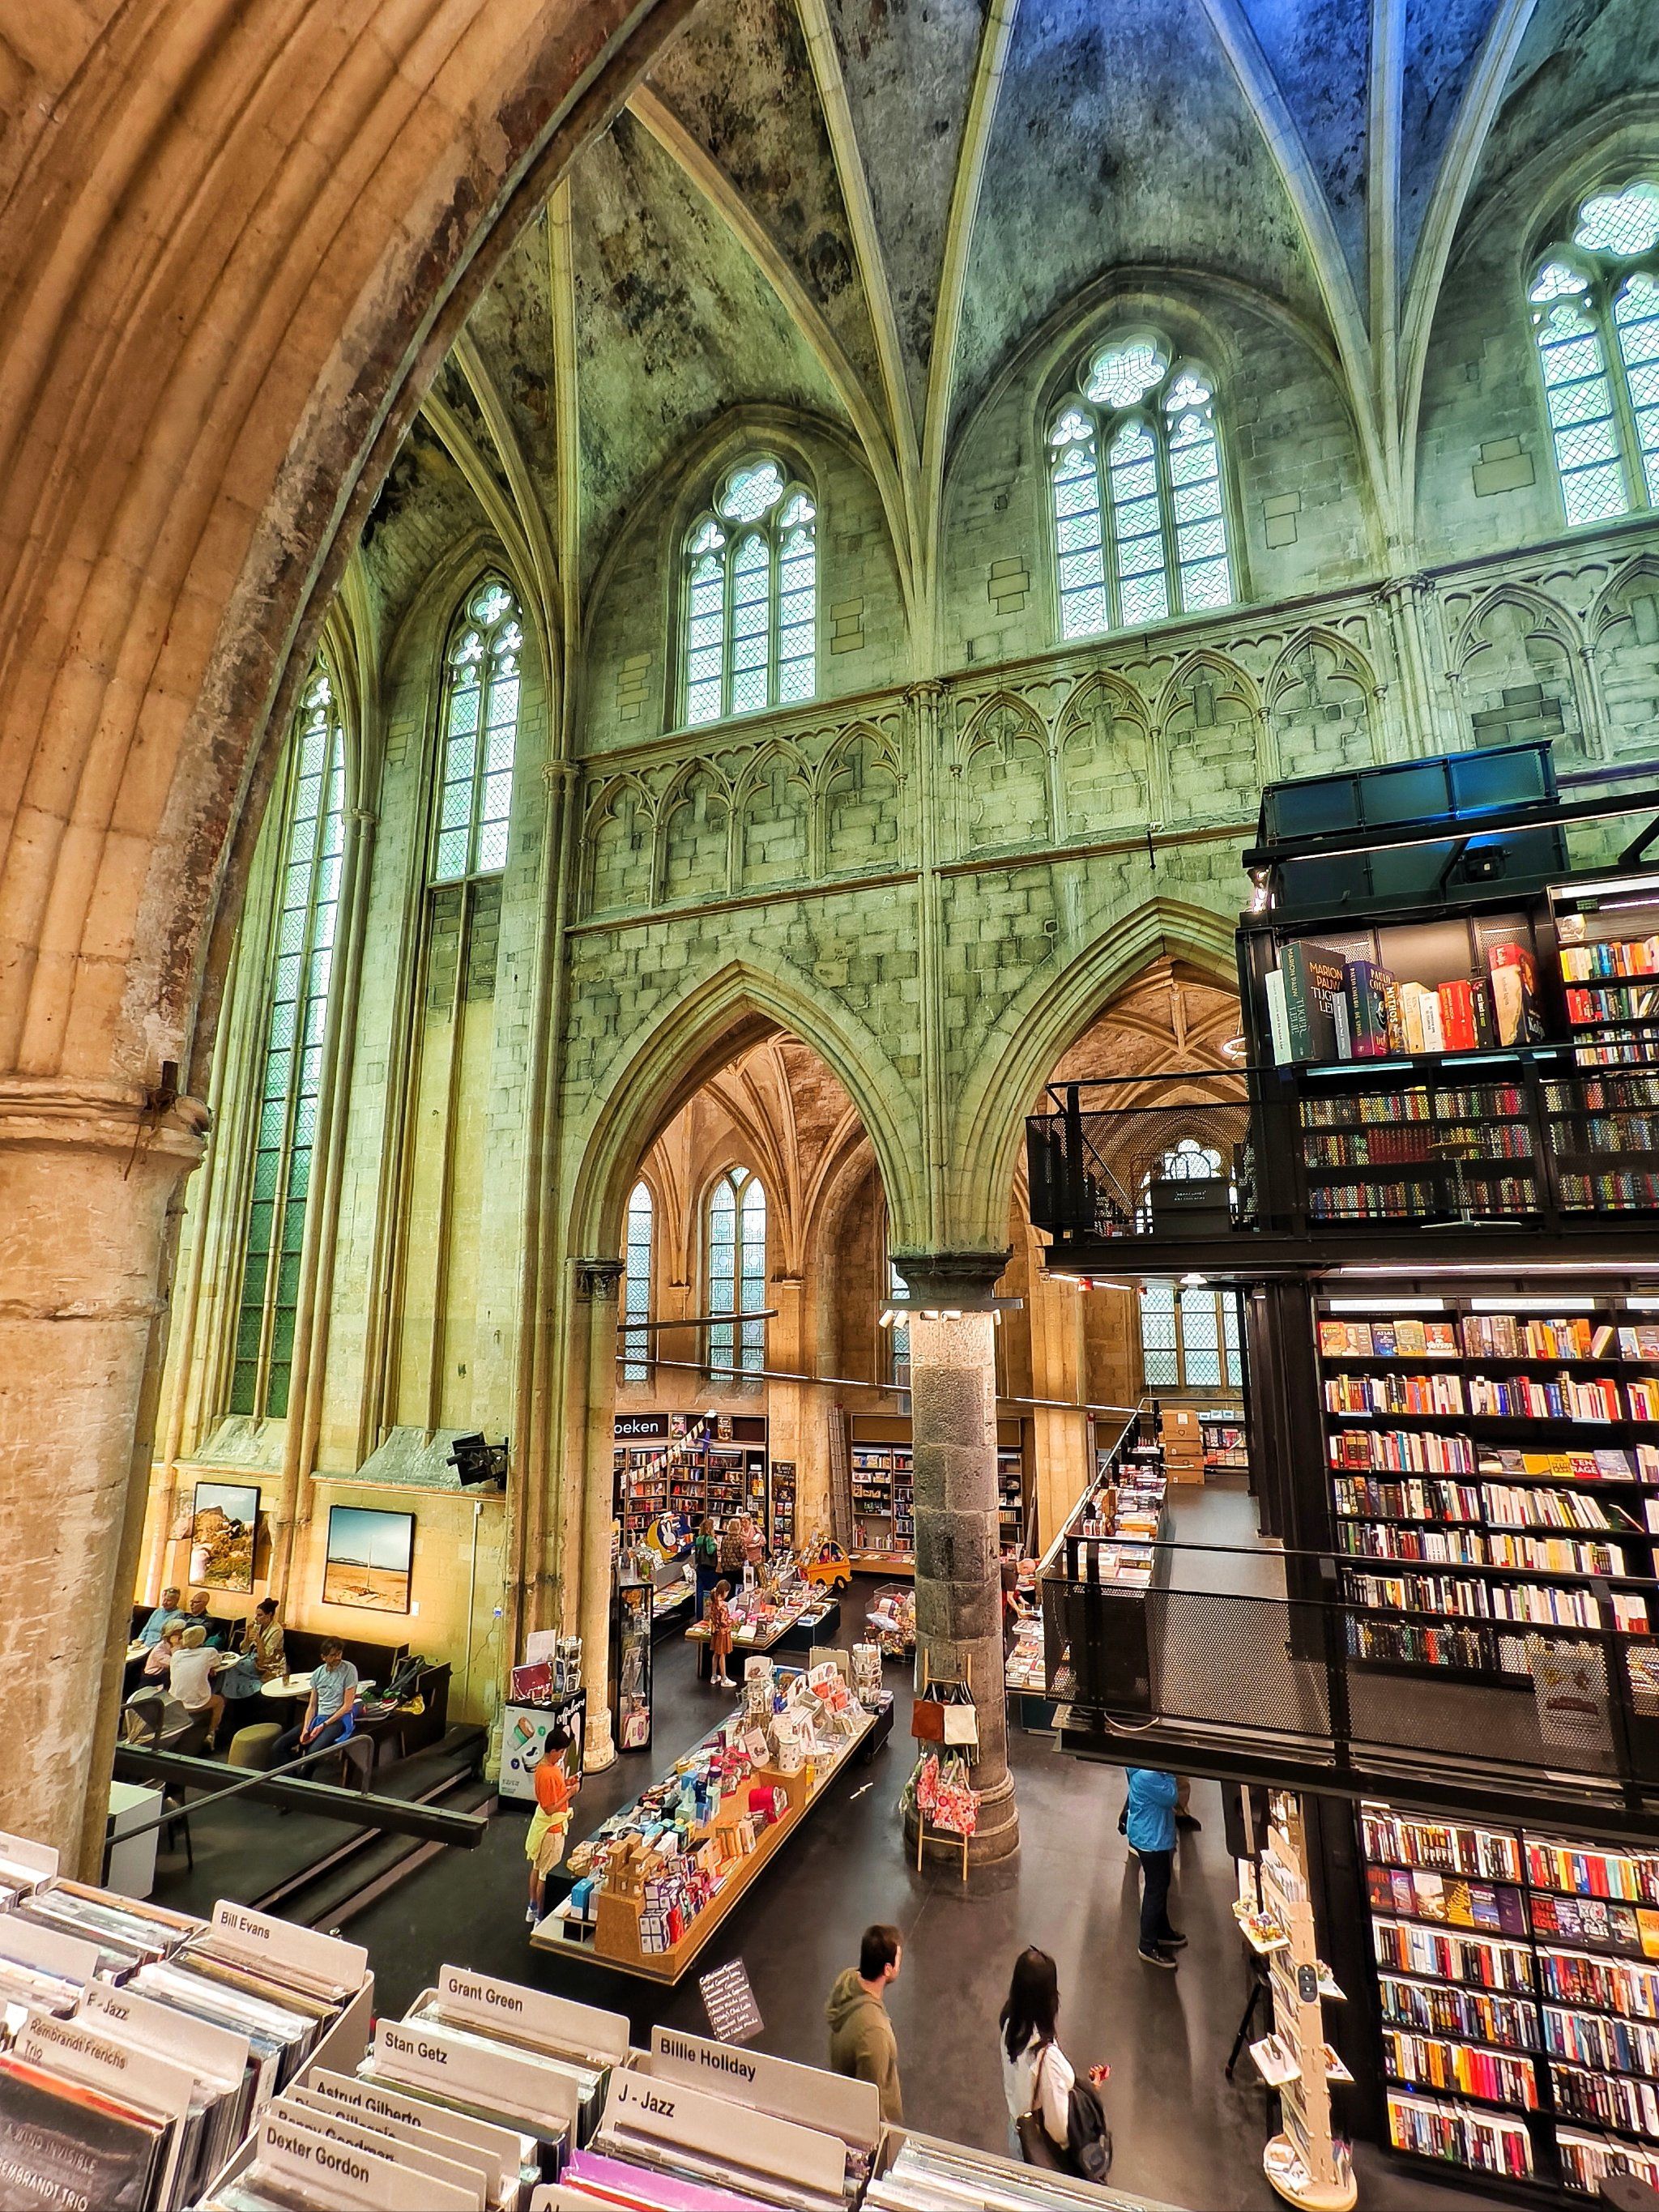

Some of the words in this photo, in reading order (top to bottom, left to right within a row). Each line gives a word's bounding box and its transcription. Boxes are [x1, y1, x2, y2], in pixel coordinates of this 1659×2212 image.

[1287, 948, 1297, 976] MARION
[1309, 961, 1343, 980] MARION
[1290, 977, 1299, 998] PAUW
[1316, 975, 1341, 991] PAUW
[1387, 987, 1398, 1023] MYTHOS
[220, 1911, 238, 1928] Bill
[239, 1917, 271, 1940] Evans
[103, 1999, 130, 2021] Jazz
[449, 1978, 482, 2001] Grant
[485, 1988, 523, 2012] Green
[24, 2039, 43, 2060] Trio
[30, 2018, 83, 2052] Rembrandt
[385, 2031, 414, 2054] Stan
[417, 2042, 448, 2065] Getz
[660, 2037, 696, 2062] Billie
[701, 2048, 757, 2083] Holiday
[317, 2082, 361, 2107] Astrud
[618, 2083, 629, 2102] J
[641, 2091, 676, 2118] Jazz
[45, 2139, 98, 2175] INVISIBLE
[267, 2126, 313, 2159] Dexter
[315, 2146, 369, 2183] Gordon
[0, 2157, 62, 2200] EMBRANDT
[62, 2187, 88, 2212] TRIO
